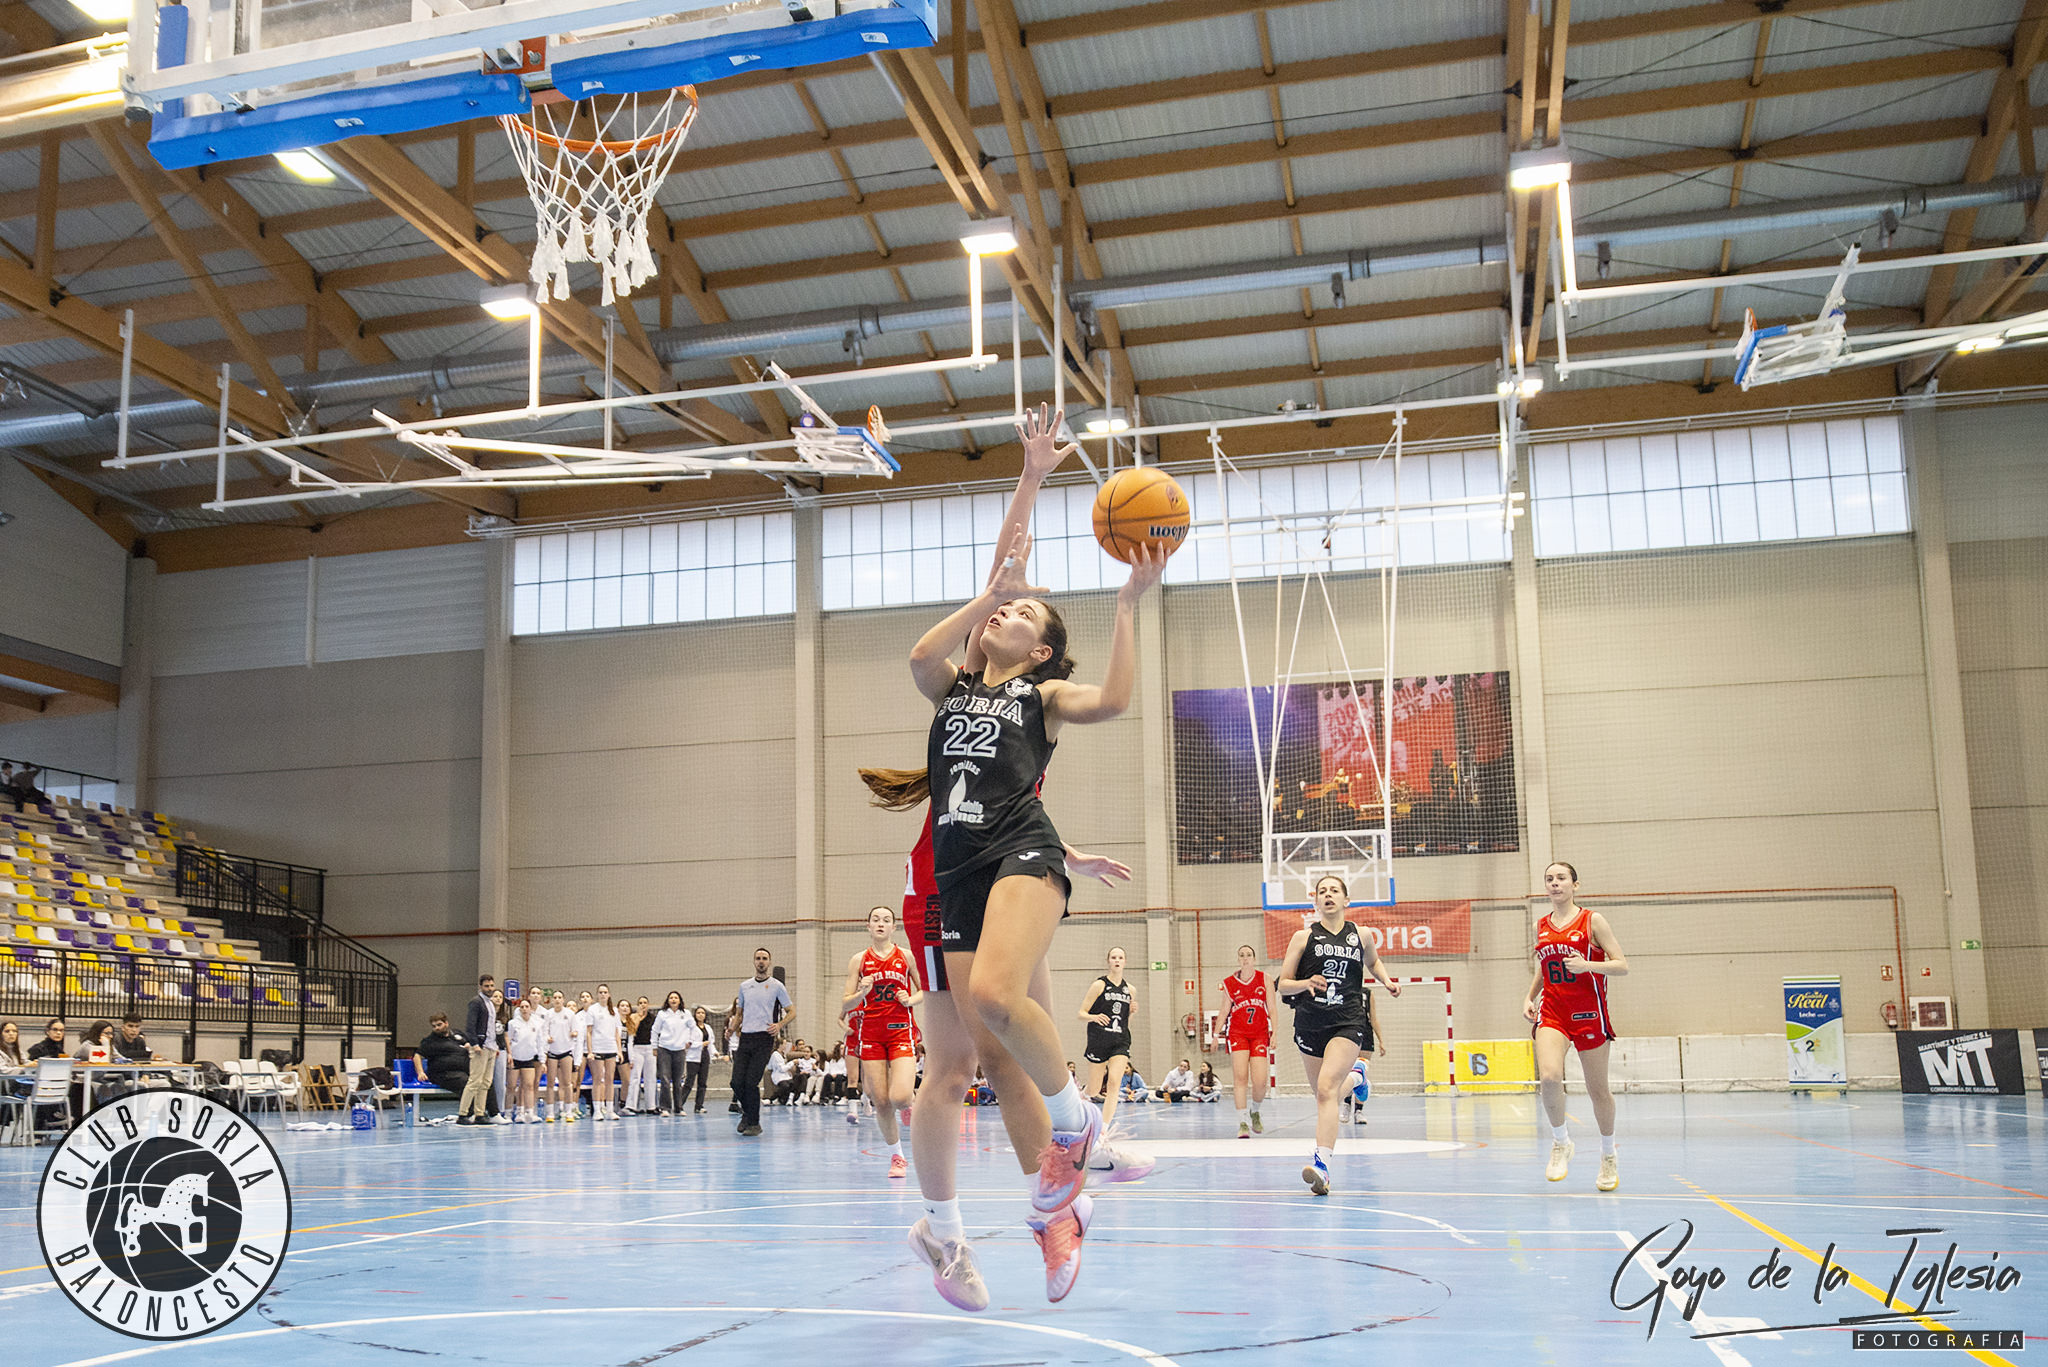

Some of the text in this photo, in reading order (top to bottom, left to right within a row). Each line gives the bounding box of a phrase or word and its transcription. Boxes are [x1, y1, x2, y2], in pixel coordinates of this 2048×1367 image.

[1149, 524, 1188, 541] ilson
[943, 714, 1001, 758] 22
[1367, 925, 1433, 950] oria
[1314, 943, 1361, 962] SORIA
[1321, 959, 1349, 978] 21
[874, 984, 896, 1002] 56
[1787, 993, 1828, 1009] Real
[1246, 1007, 1256, 1025] 7
